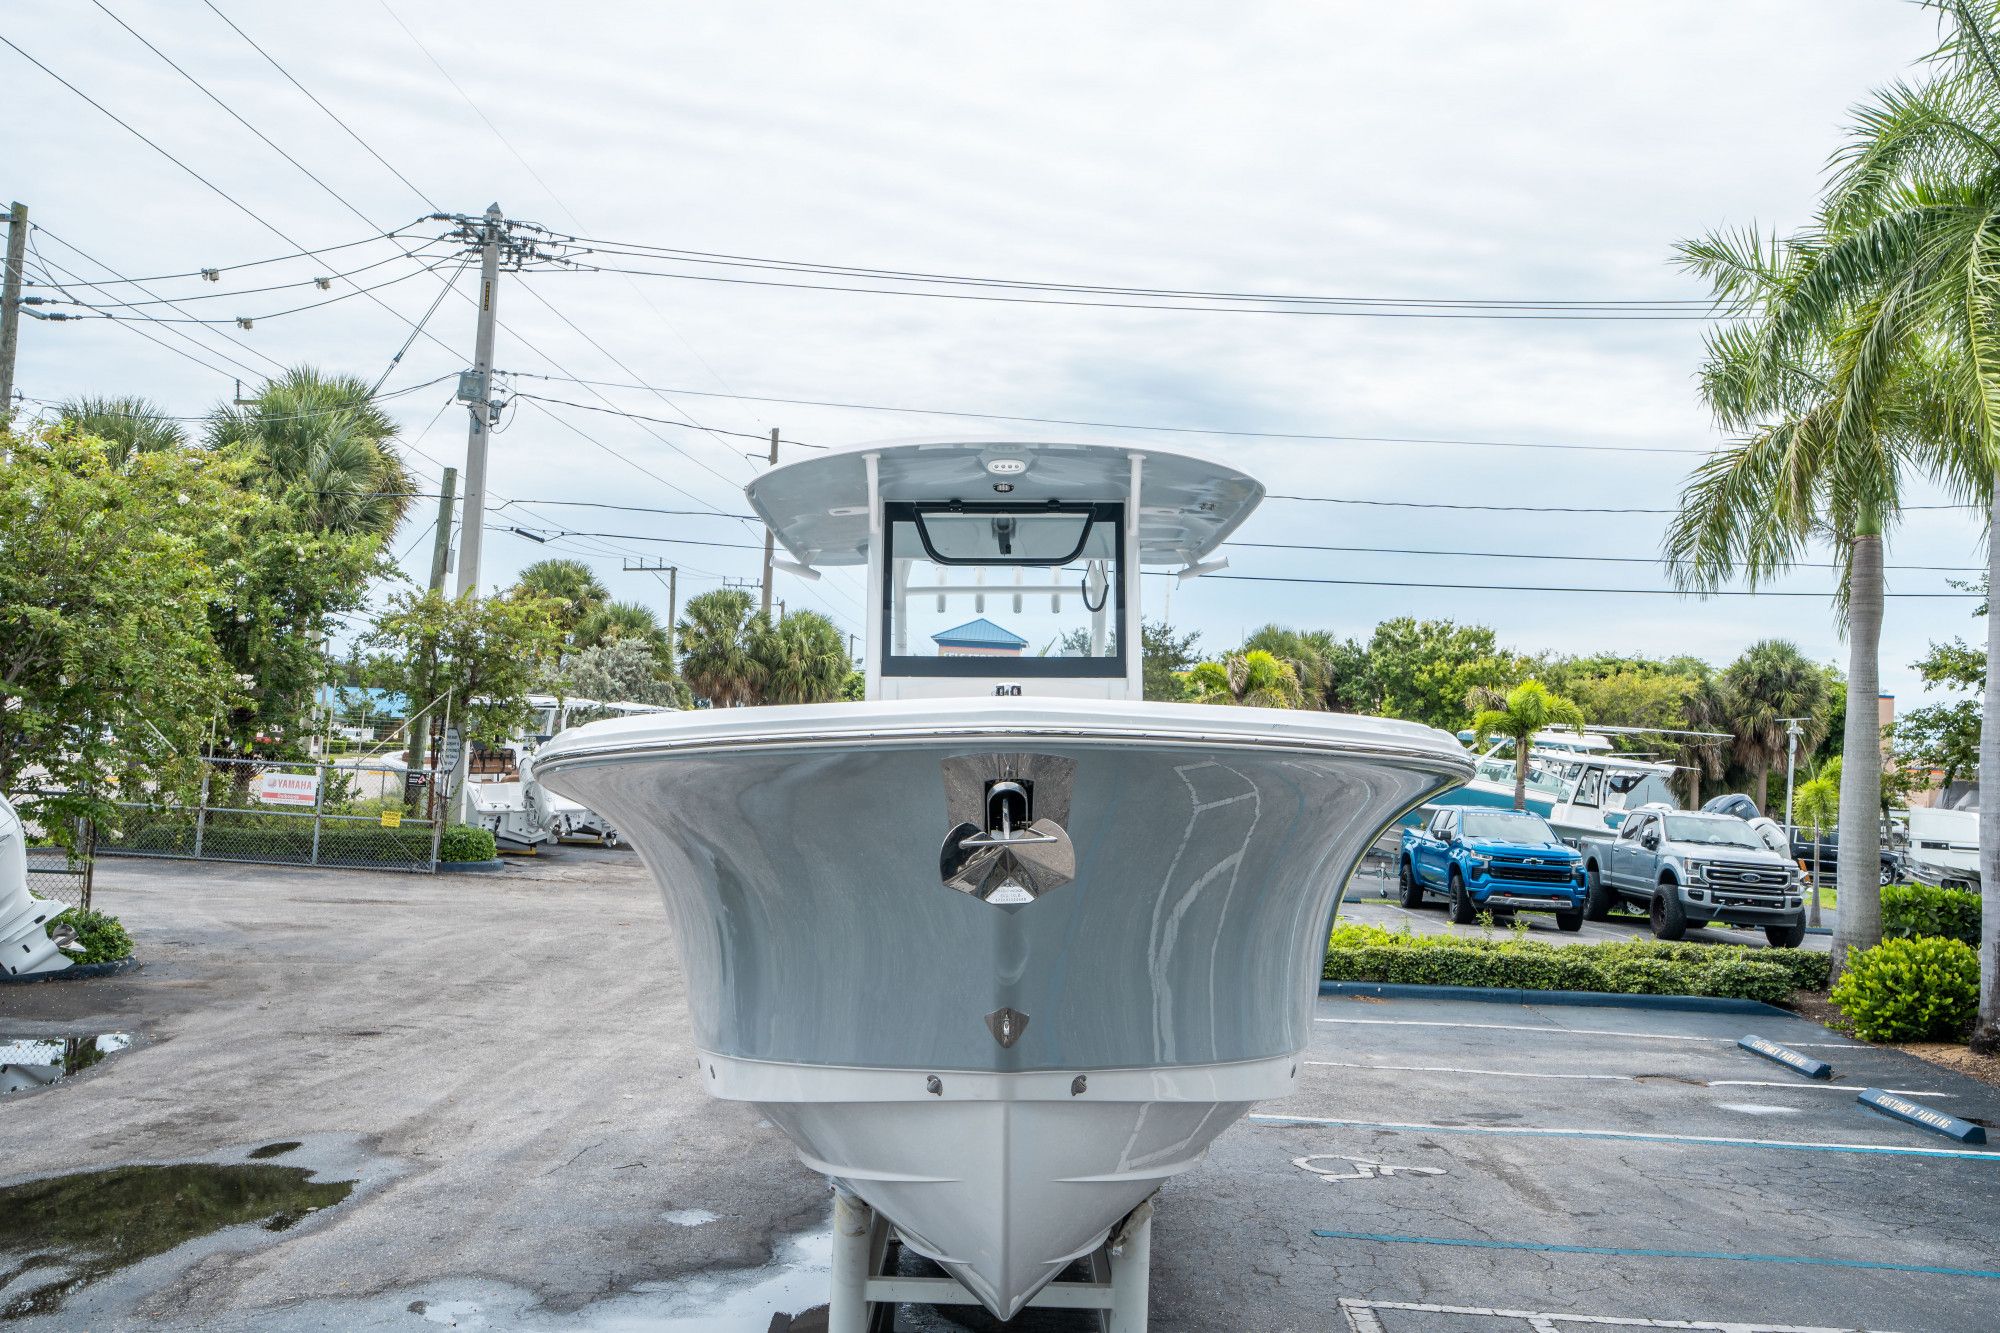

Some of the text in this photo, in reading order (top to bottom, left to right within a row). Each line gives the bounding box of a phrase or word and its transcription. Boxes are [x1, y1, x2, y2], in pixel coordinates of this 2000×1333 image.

[278, 779, 312, 790] YAMAHA
[1751, 1040, 1807, 1067] CUSTOMER PARKING
[1876, 1095, 1952, 1129] CUSTOMER PARKING
